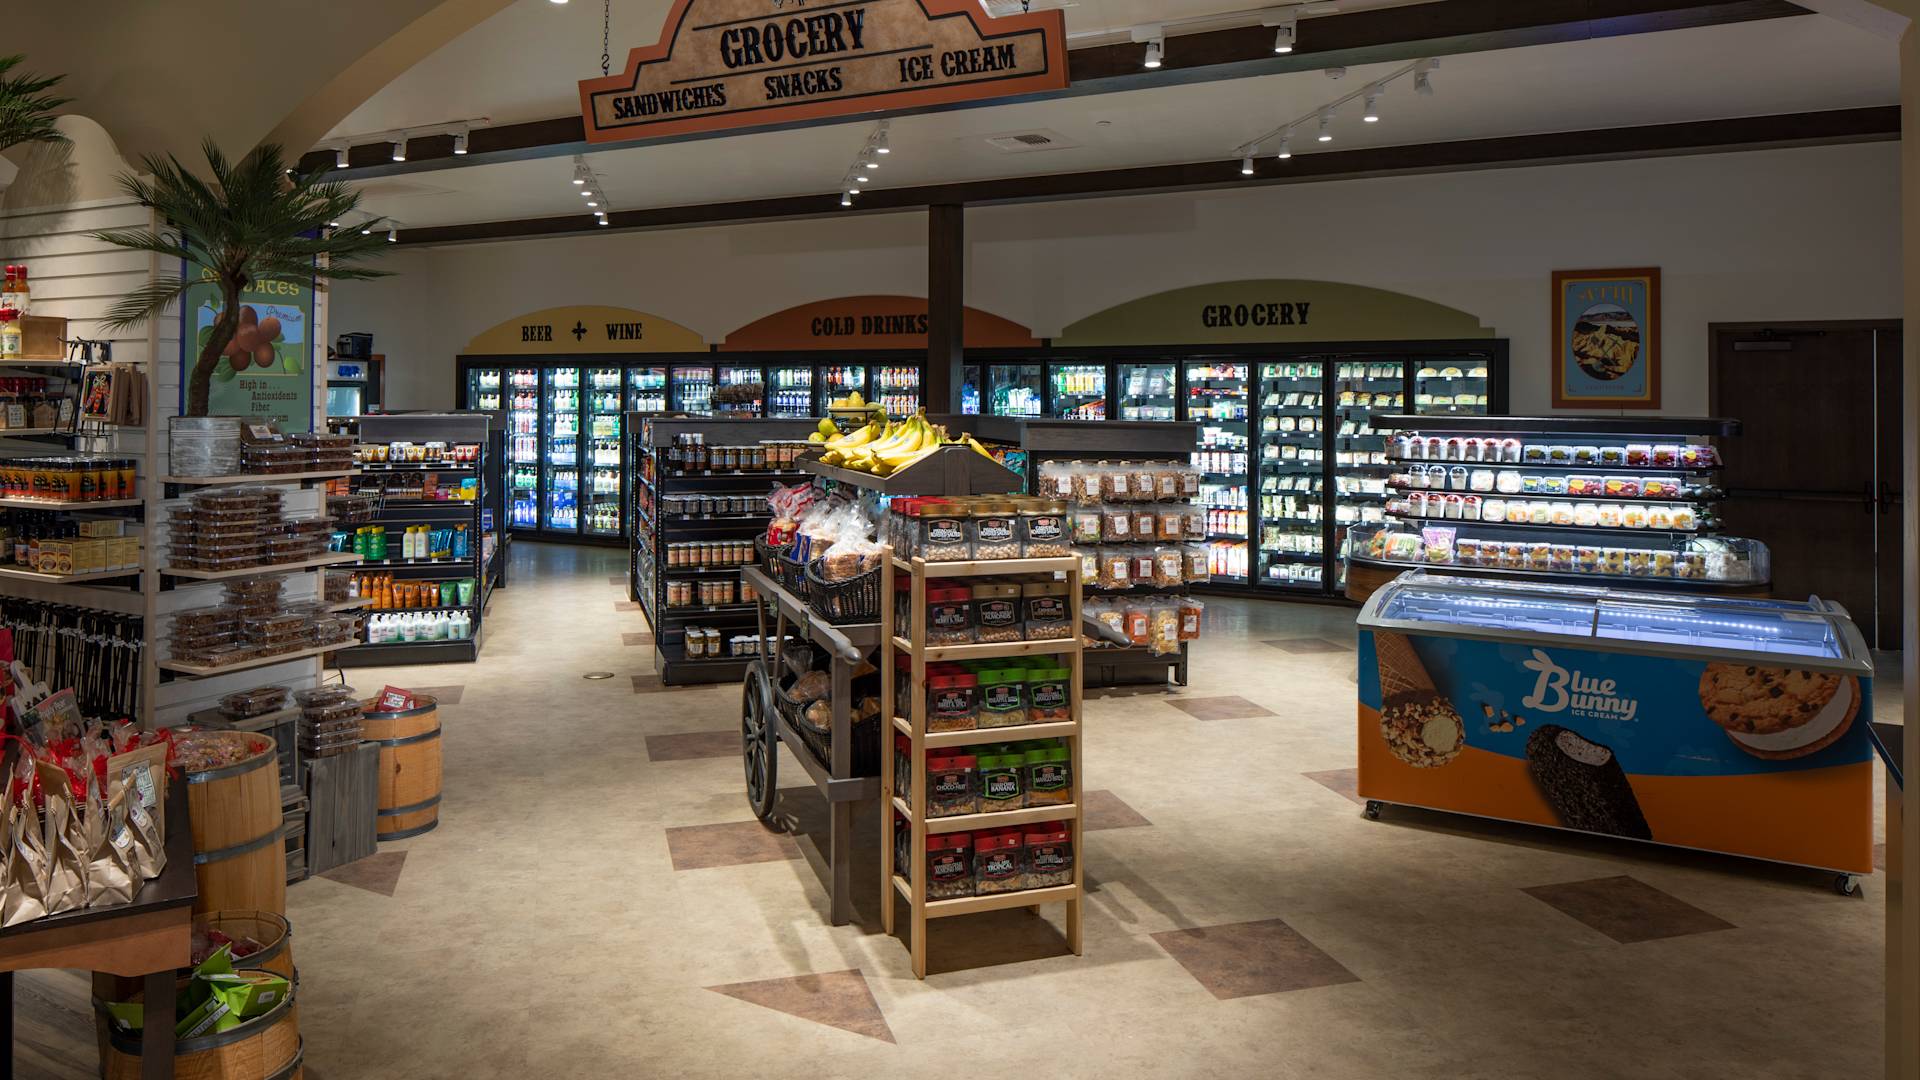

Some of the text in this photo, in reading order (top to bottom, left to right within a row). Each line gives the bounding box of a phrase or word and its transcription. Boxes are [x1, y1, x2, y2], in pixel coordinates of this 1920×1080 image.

[720, 9, 865, 68] GROCERY
[614, 44, 1017, 120] SANDWICHES SNACKS ICE CREAM
[811, 314, 928, 336] COLD DRINKS
[1202, 303, 1310, 327] GROCERY
[521, 323, 642, 342] BEER WINE
[239, 380, 257, 391] High
[251, 402, 270, 411] Fiber
[1588, 711, 1618, 720] CREAM
